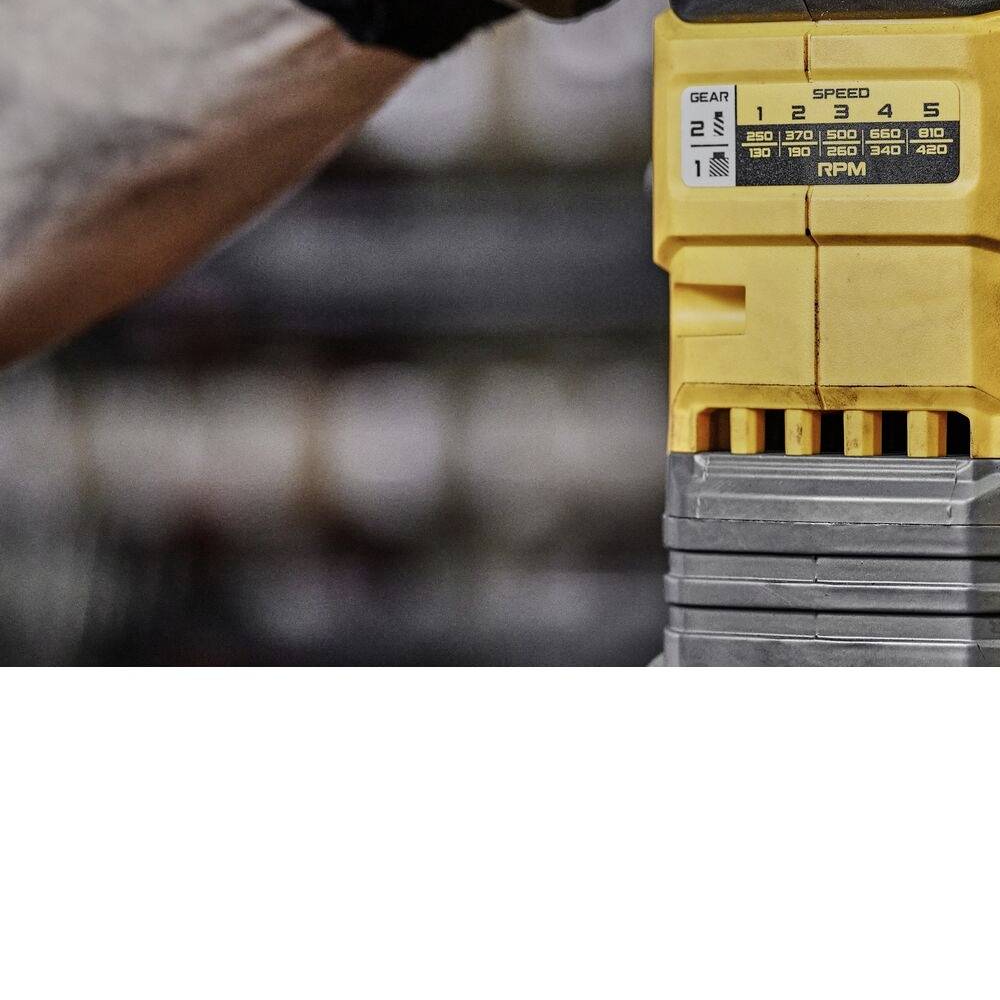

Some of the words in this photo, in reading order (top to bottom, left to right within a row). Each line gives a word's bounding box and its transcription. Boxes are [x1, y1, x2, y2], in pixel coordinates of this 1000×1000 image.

[689, 91, 729, 103] GEAR
[812, 87, 870, 100] SPEED
[756, 106, 763, 121] 1
[791, 105, 806, 120] 2
[833, 104, 849, 119] 3
[877, 103, 893, 118] 4
[923, 102, 940, 117] 5
[690, 120, 705, 137] 2
[746, 130, 774, 141] 250
[785, 129, 813, 140] 370
[826, 129, 857, 140] 500
[869, 128, 901, 139] 660
[918, 127, 945, 138] 810
[788, 146, 811, 158] 190
[826, 145, 857, 157] 260
[870, 144, 901, 156] 340
[916, 144, 948, 155] 420
[694, 160, 701, 177] 1
[817, 161, 867, 177] RPM
